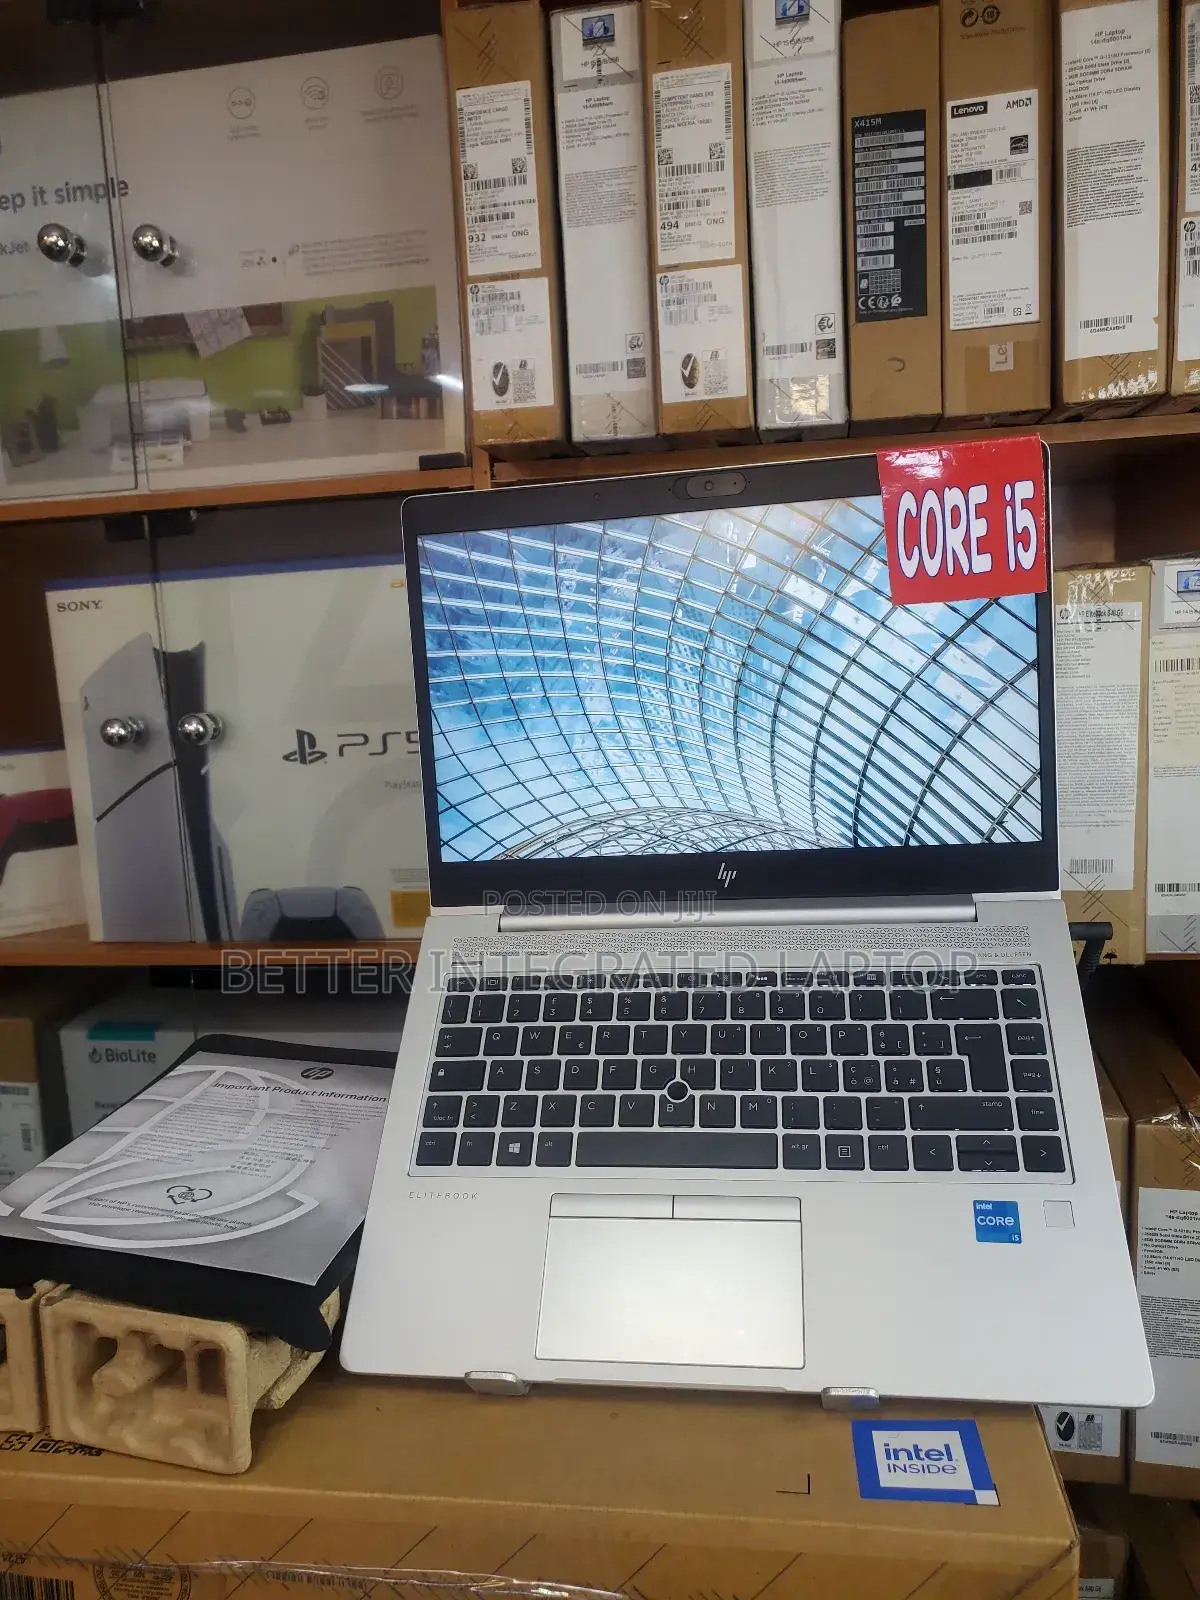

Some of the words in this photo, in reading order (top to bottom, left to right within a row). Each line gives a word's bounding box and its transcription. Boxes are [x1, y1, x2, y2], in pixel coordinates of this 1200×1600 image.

[1105, 28, 1126, 37] Laptop
[773, 40, 783, 48] HP
[785, 70, 804, 78] Laptop
[689, 91, 714, 99] HANDLERS
[953, 104, 984, 116] Lenovo
[1005, 98, 1025, 109] AMD
[854, 117, 882, 128] X415M
[32, 185, 48, 208] it
[54, 176, 130, 205] simple
[660, 220, 680, 231] 494
[706, 217, 725, 226] ONG
[468, 233, 487, 244] 932
[511, 229, 530, 238] ONG
[896, 484, 993, 579] CORE
[1003, 480, 1039, 572] i5
[56, 599, 103, 613] SONY
[336, 730, 420, 758] PS5
[513, 1008, 520, 1016] 2
[550, 1008, 556, 1016] 3
[586, 1008, 593, 1016] 4
[623, 1007, 630, 1015] 5
[738, 1006, 745, 1014] 8
[777, 1006, 784, 1014] 9
[492, 1032, 501, 1041] Q
[529, 1031, 541, 1040] W
[565, 1031, 572, 1040] E
[603, 1031, 610, 1039] R
[640, 1031, 647, 1039] T
[680, 1030, 687, 1038] Y
[718, 1030, 726, 1039] U
[799, 1030, 807, 1039] O
[838, 1030, 846, 1039] P
[105, 1047, 156, 1063] BioLite
[496, 1066, 505, 1075] A
[534, 1066, 541, 1075] S
[571, 1066, 579, 1074] D
[610, 1066, 617, 1074] F
[649, 1065, 658, 1074] G
[688, 1065, 696, 1073] H
[728, 1065, 734, 1074] J
[768, 1066, 776, 1074] K
[809, 1066, 816, 1075] L
[213, 1082, 271, 1092] Important
[272, 1086, 318, 1097] Product
[318, 1090, 387, 1103] Information
[509, 1102, 517, 1110] Z
[548, 1102, 556, 1110] X
[587, 1102, 595, 1110] C
[627, 1102, 635, 1110] V
[666, 1104, 674, 1112] B
[707, 1102, 716, 1110] N
[749, 1102, 758, 1111] M
[408, 1191, 478, 1200] ELITEBOOK
[132, 1202, 174, 1214] commitment
[975, 1202, 993, 1210] intel
[101, 1203, 131, 1213] envelope
[132, 1207, 159, 1216] replaces
[201, 1219, 222, 1228] plastic
[1011, 1234, 1020, 1242] i5
[883, 1442, 954, 1462] intel
